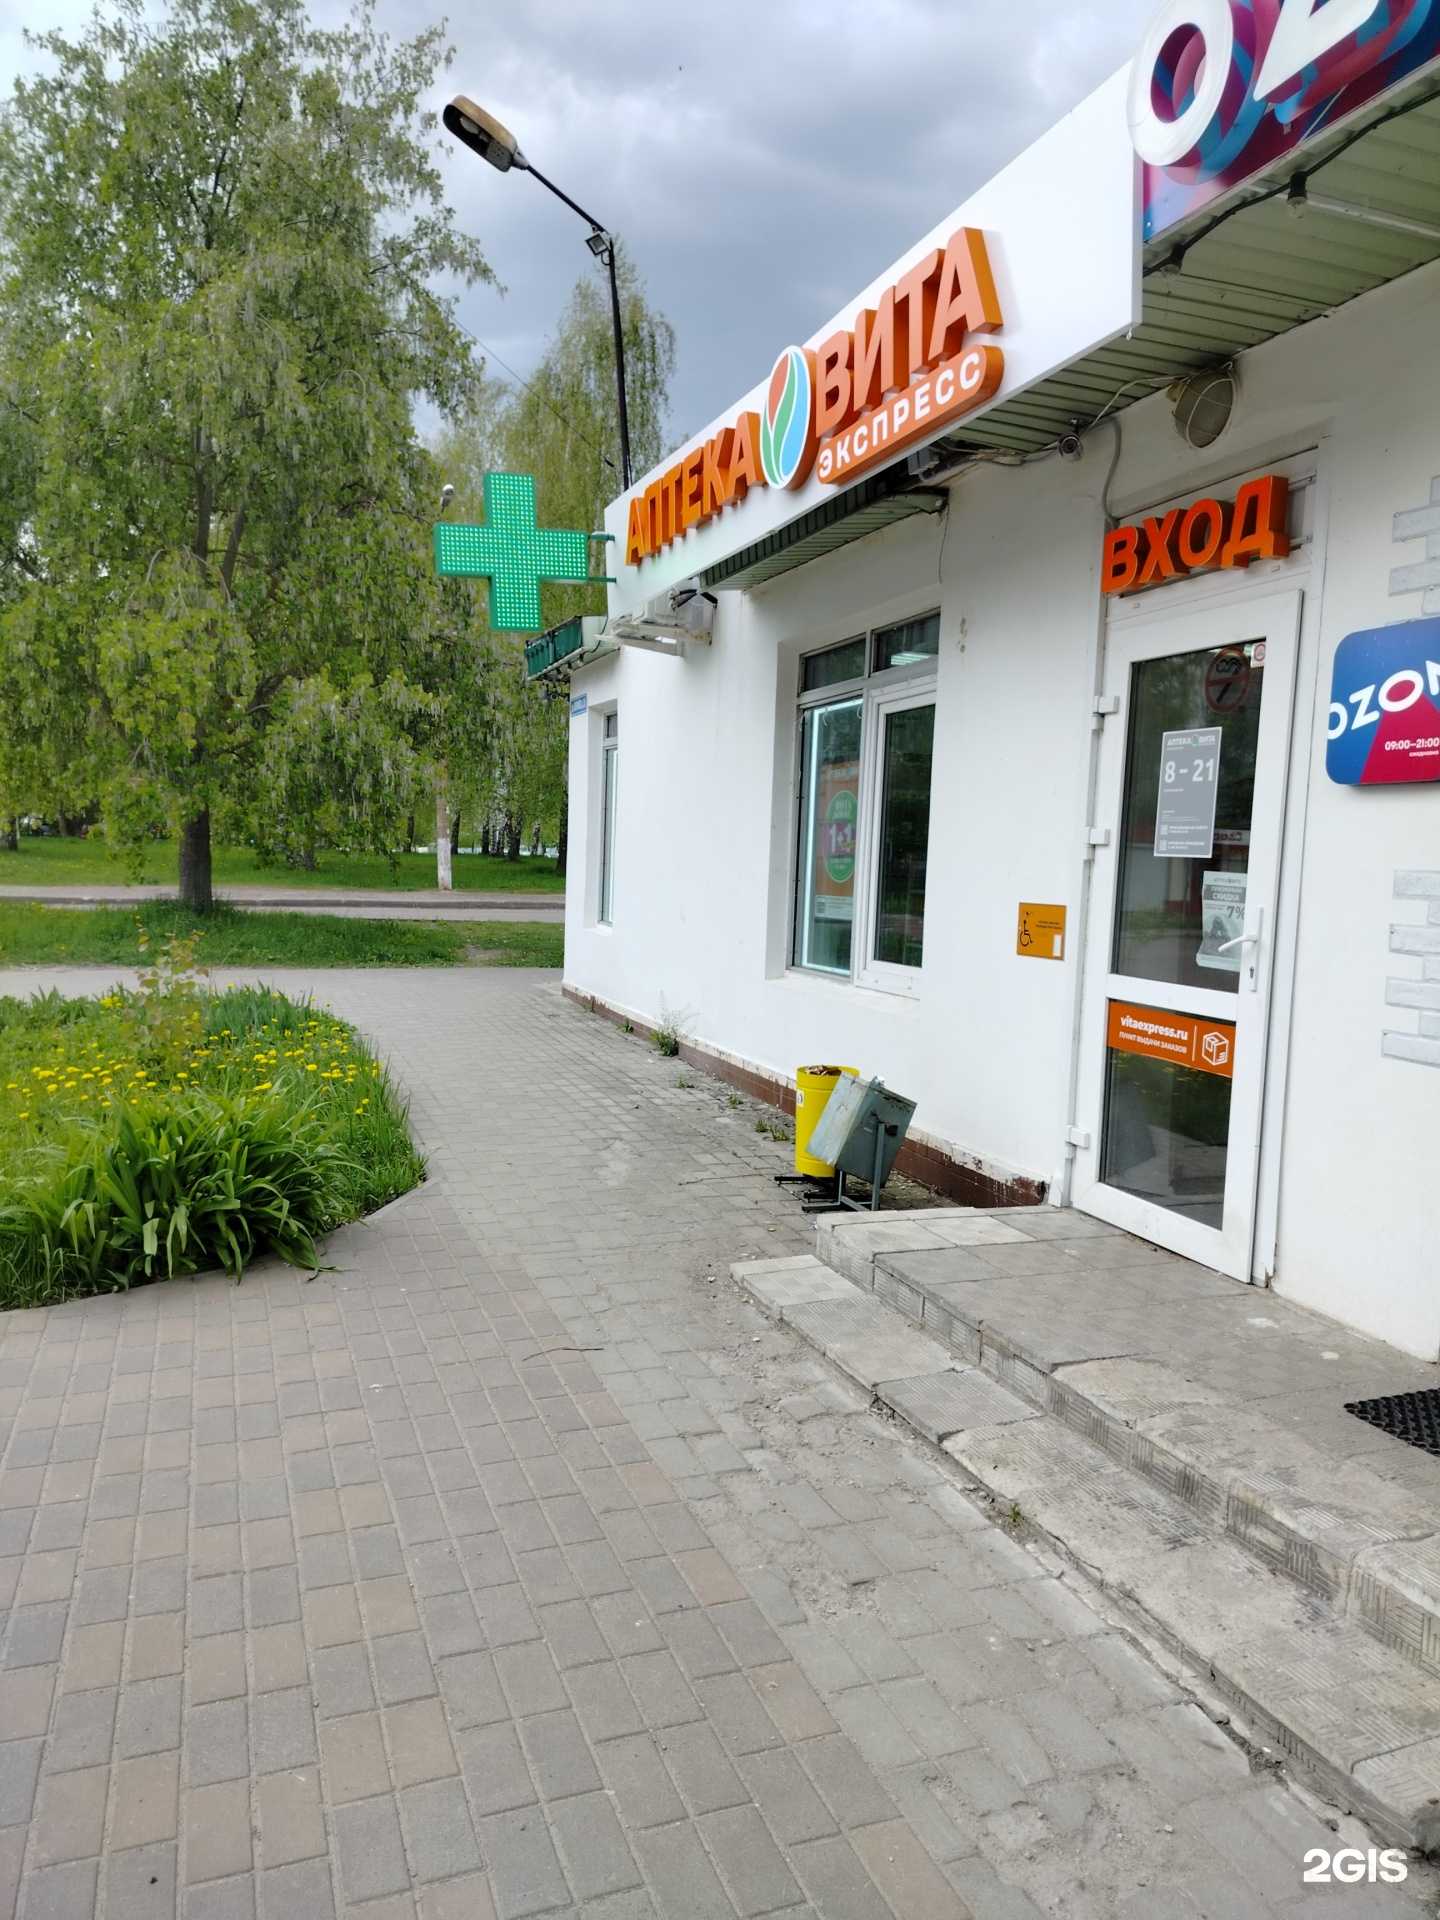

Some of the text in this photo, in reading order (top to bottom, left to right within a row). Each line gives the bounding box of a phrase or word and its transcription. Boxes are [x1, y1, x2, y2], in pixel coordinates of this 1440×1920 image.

[625, 226, 1003, 566] АПТЕКА ВИТА
[818, 351, 983, 480] ЭКСПРЕСС
[1101, 474, 1289, 592] ВХОД
[1164, 760, 1176, 783] 8
[1191, 758, 1215, 782] 21
[1120, 1015, 1189, 1041] vitaexpress.ru
